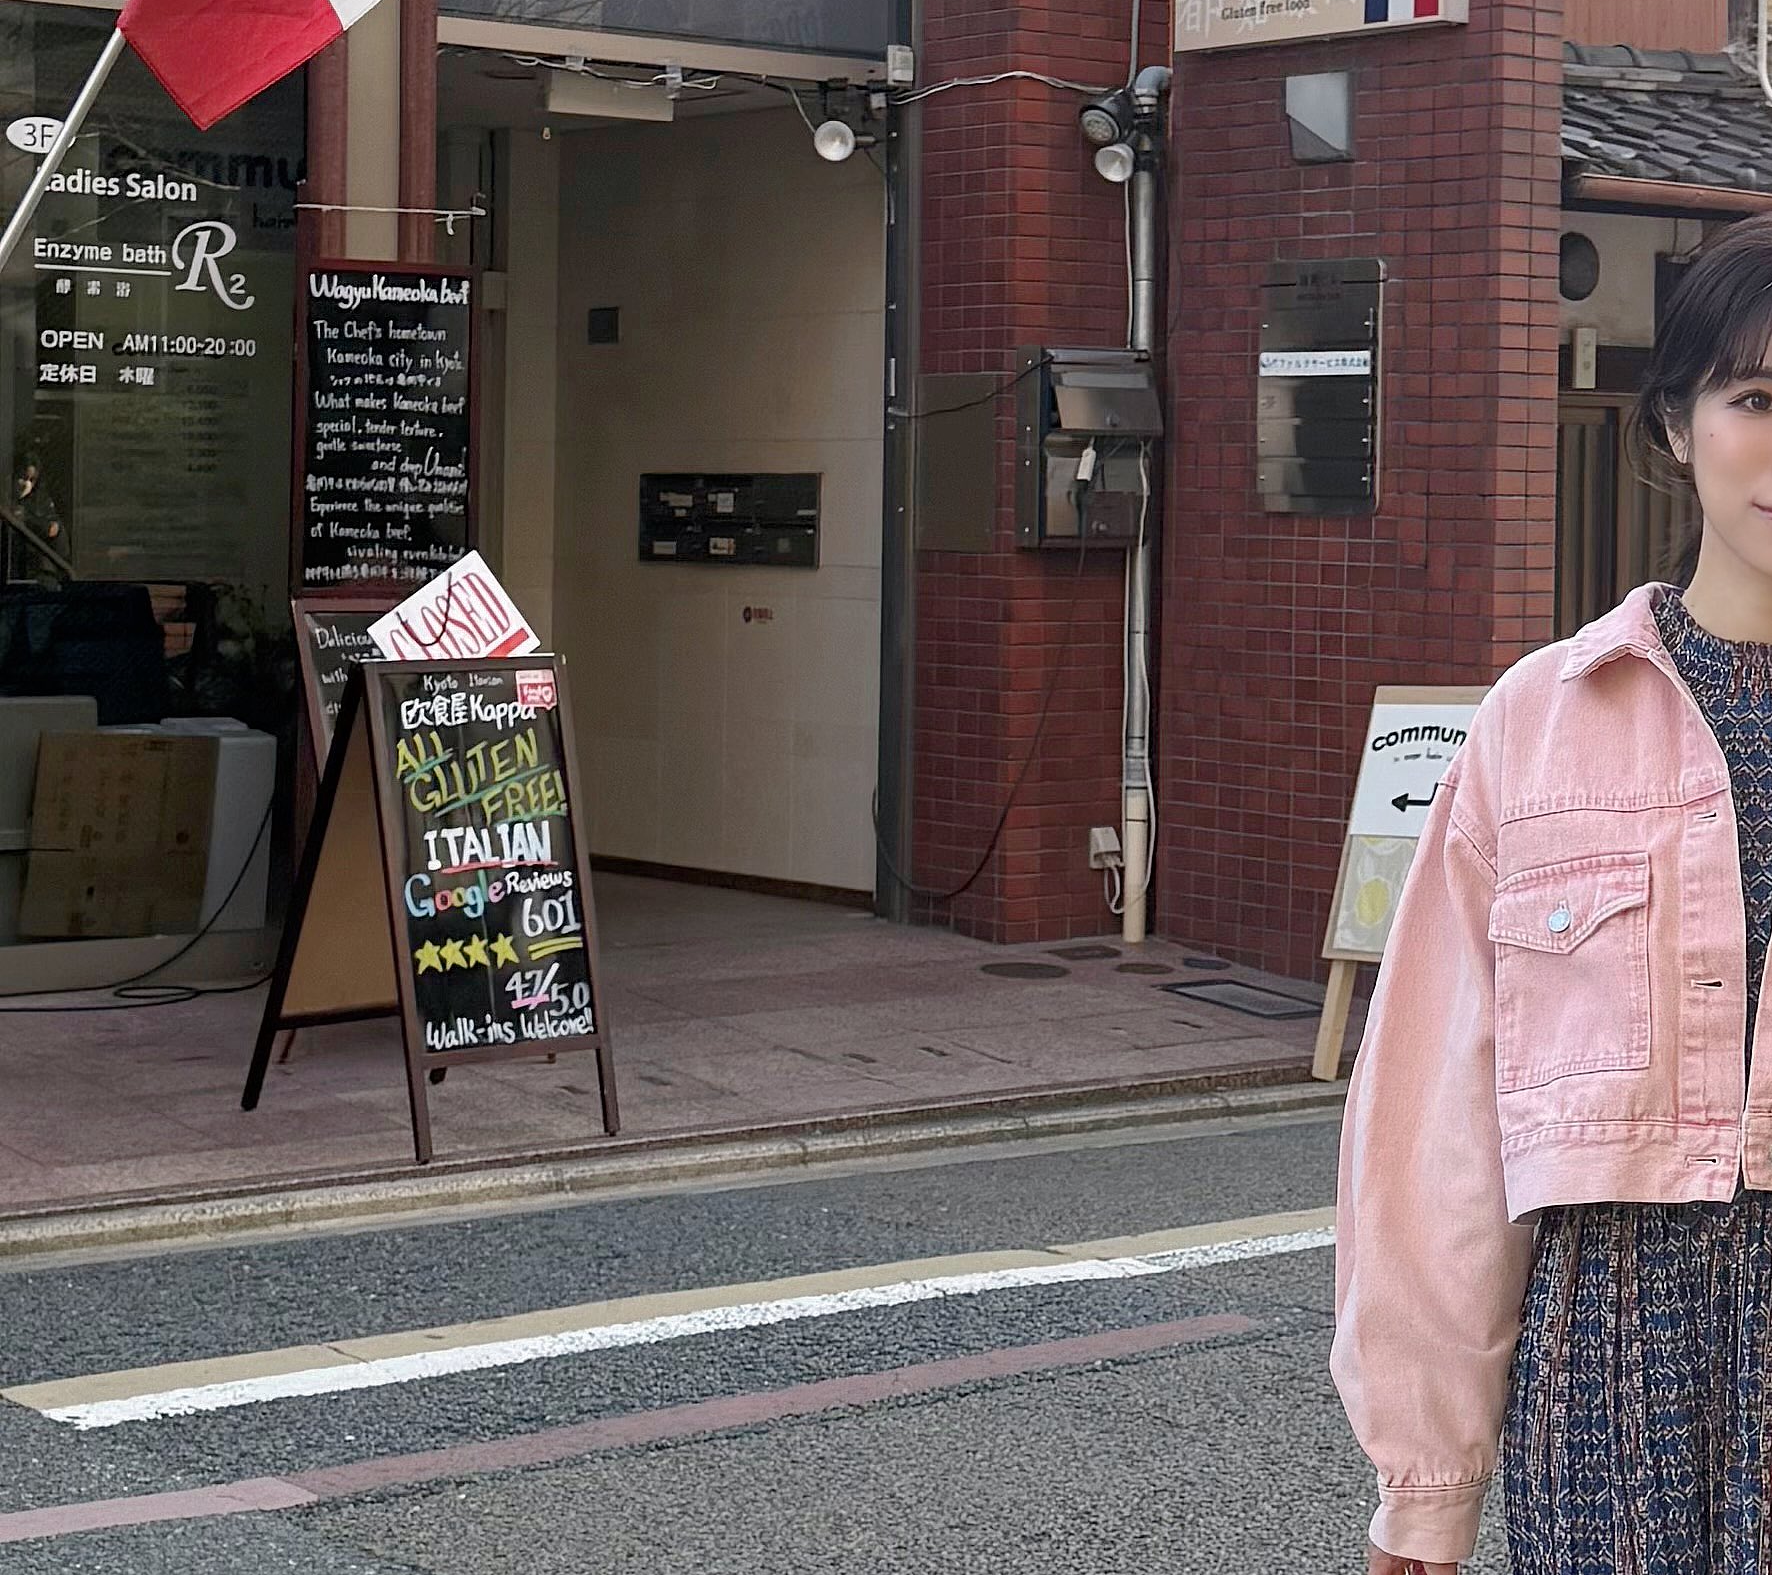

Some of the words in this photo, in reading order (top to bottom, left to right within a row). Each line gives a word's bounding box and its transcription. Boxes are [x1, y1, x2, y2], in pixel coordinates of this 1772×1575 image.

[23, 123, 54, 148] 3F
[126, 173, 197, 202] Salon
[34, 238, 112, 261] Enzyme
[122, 243, 167, 264] bath
[40, 329, 104, 350] OPEN
[313, 320, 339, 340] The
[39, 363, 97, 384] 定休日
[389, 348, 414, 373] city
[420, 351, 432, 368] in
[314, 391, 351, 410] What
[371, 455, 397, 472] and
[423, 674, 459, 697] Kyoto
[1372, 726, 1468, 752] commun
[396, 730, 446, 779] ALL
[409, 727, 539, 813] GLUTEN
[423, 820, 552, 870] ITALIAN
[404, 869, 506, 918] Google
[505, 871, 573, 895] Reviews
[522, 889, 581, 938] 601
[426, 1013, 516, 1051] Walk-ins
